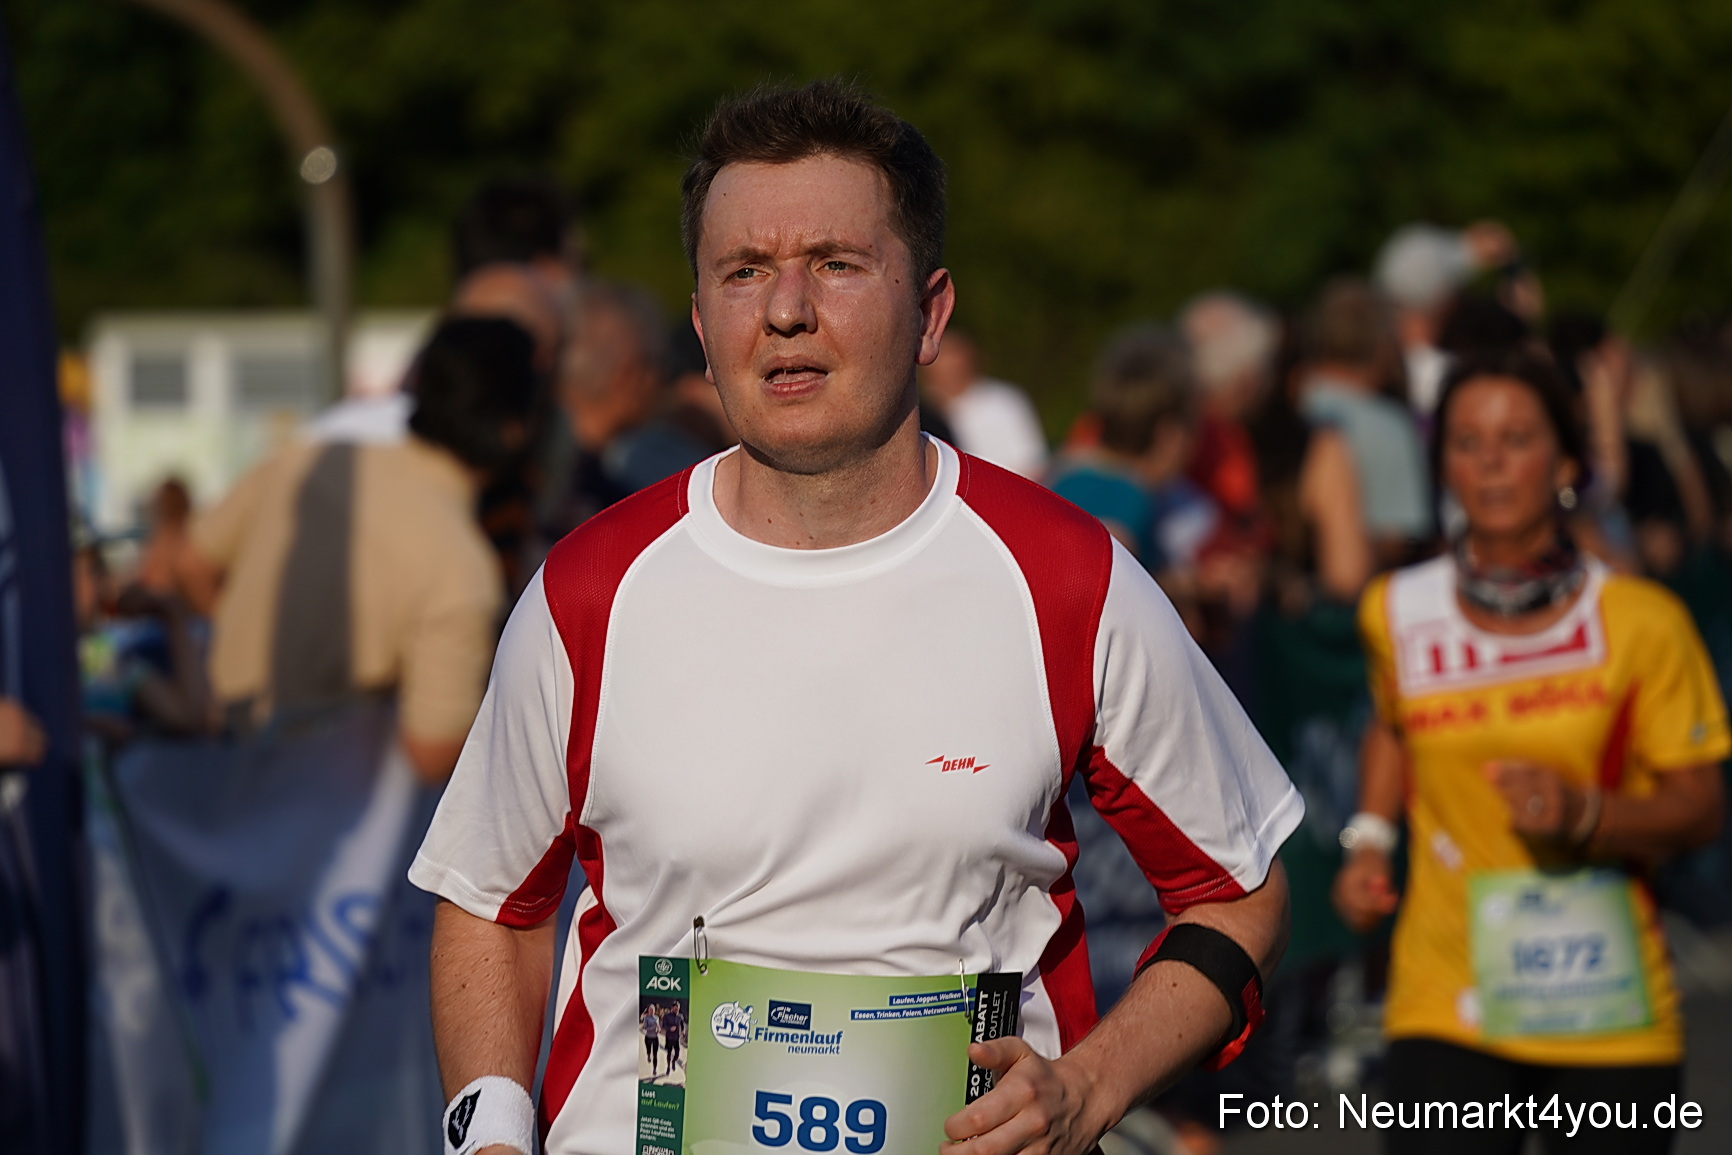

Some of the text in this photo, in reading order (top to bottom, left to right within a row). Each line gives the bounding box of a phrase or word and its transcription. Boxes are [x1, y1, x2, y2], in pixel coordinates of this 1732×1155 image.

[942, 757, 976, 772] DEHN
[645, 975, 682, 992] AOK
[892, 992, 962, 1005] Laufen, Joggen, Walken
[775, 1006, 809, 1022] Fischer
[974, 990, 989, 1045] ABATT
[988, 991, 1002, 1039] OUTLET
[754, 1027, 843, 1045] Firmenlauf
[787, 1044, 840, 1055] neumarkt
[970, 1073, 981, 1097] 20
[641, 1089, 656, 1099] Lust
[751, 1090, 888, 1155] 589
